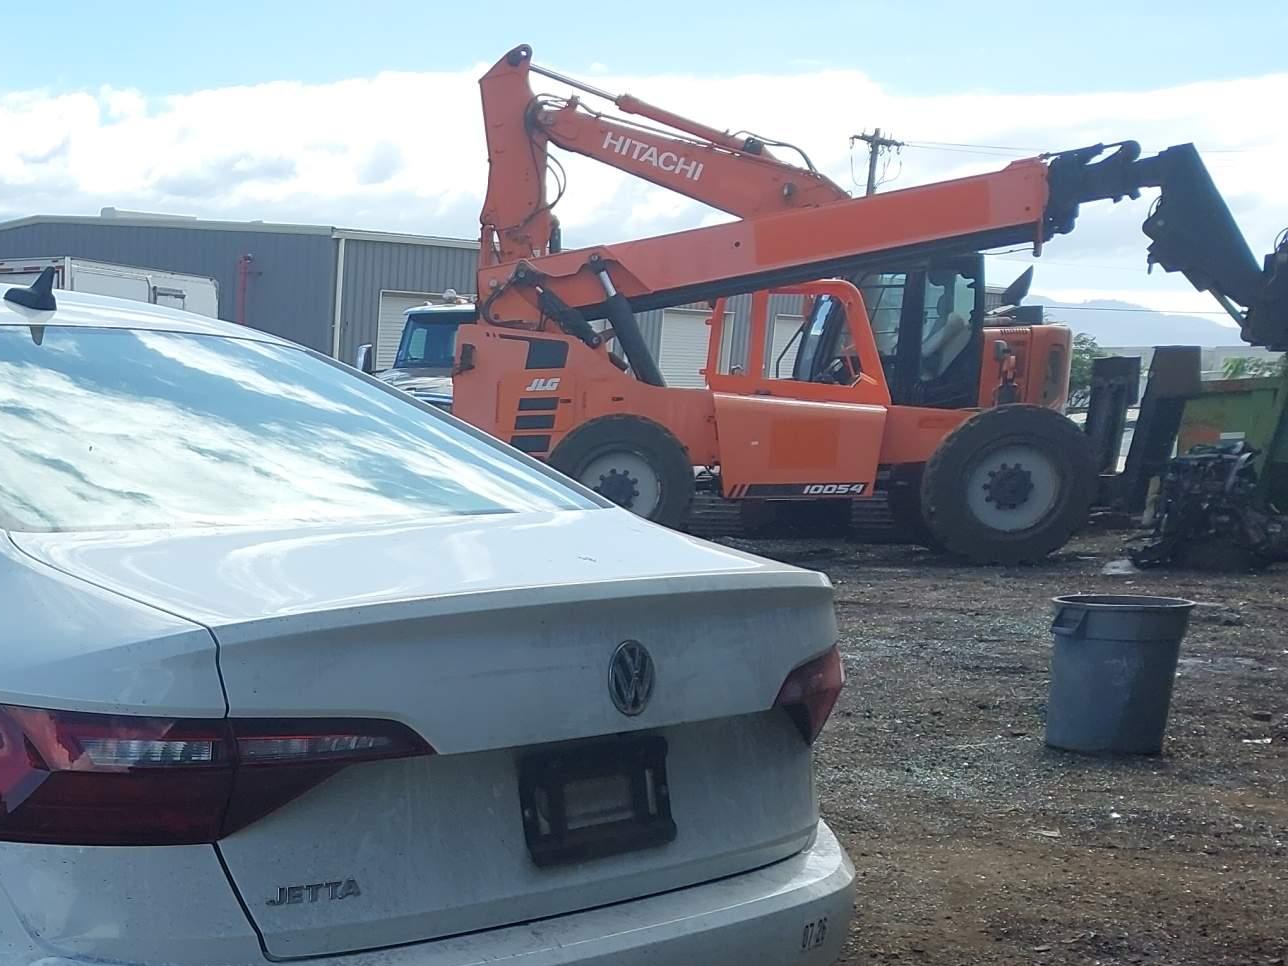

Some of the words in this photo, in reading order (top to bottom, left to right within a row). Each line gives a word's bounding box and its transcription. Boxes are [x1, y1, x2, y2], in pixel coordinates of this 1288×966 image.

[602, 131, 704, 181] HITACHI
[526, 377, 561, 392] JLG
[802, 483, 866, 495] 10054
[265, 878, 362, 906] JETTA
